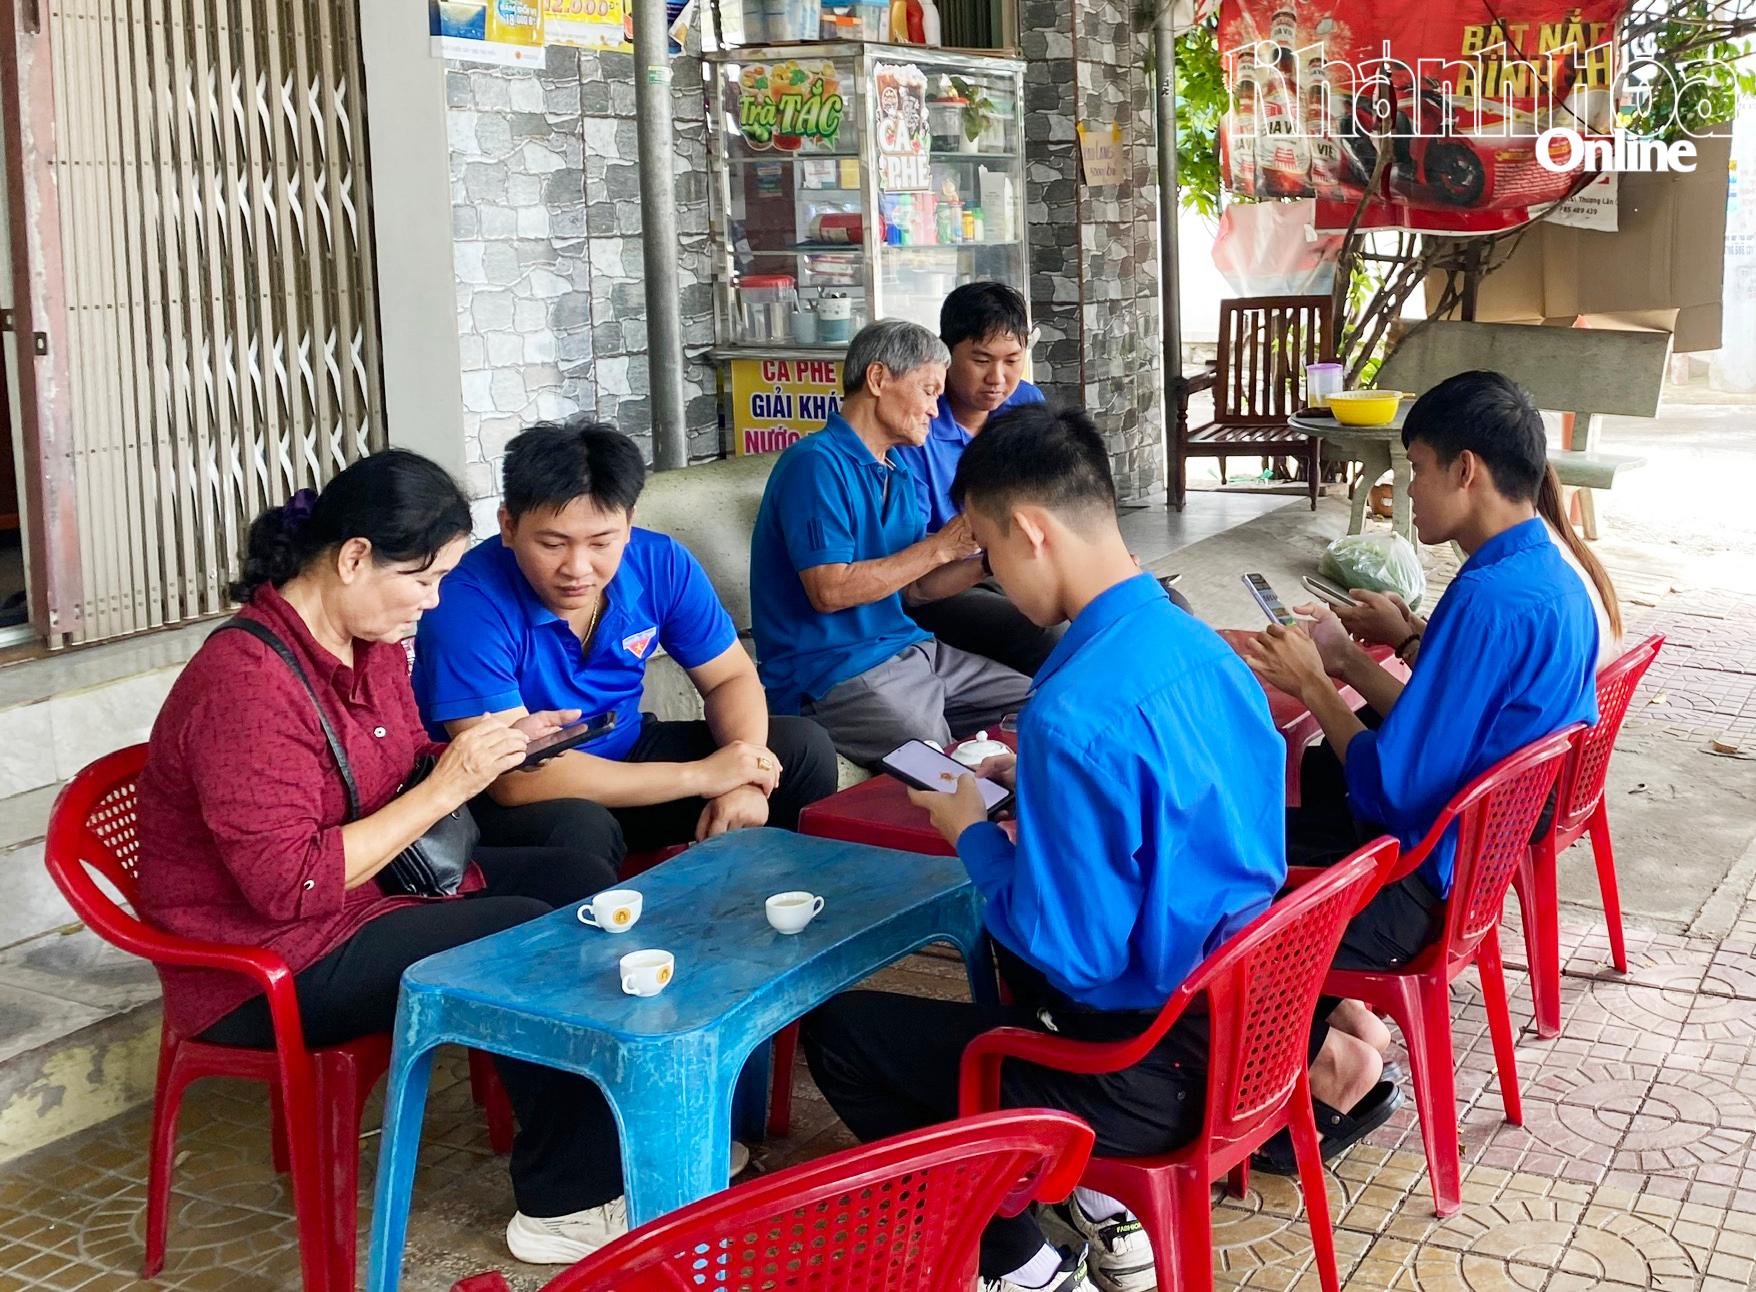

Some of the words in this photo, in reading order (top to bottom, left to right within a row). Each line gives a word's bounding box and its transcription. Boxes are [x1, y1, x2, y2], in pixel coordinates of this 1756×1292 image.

[739, 95, 777, 127] Trà
[751, 385, 793, 419] GIẢI
[798, 391, 844, 420] KHÁ
